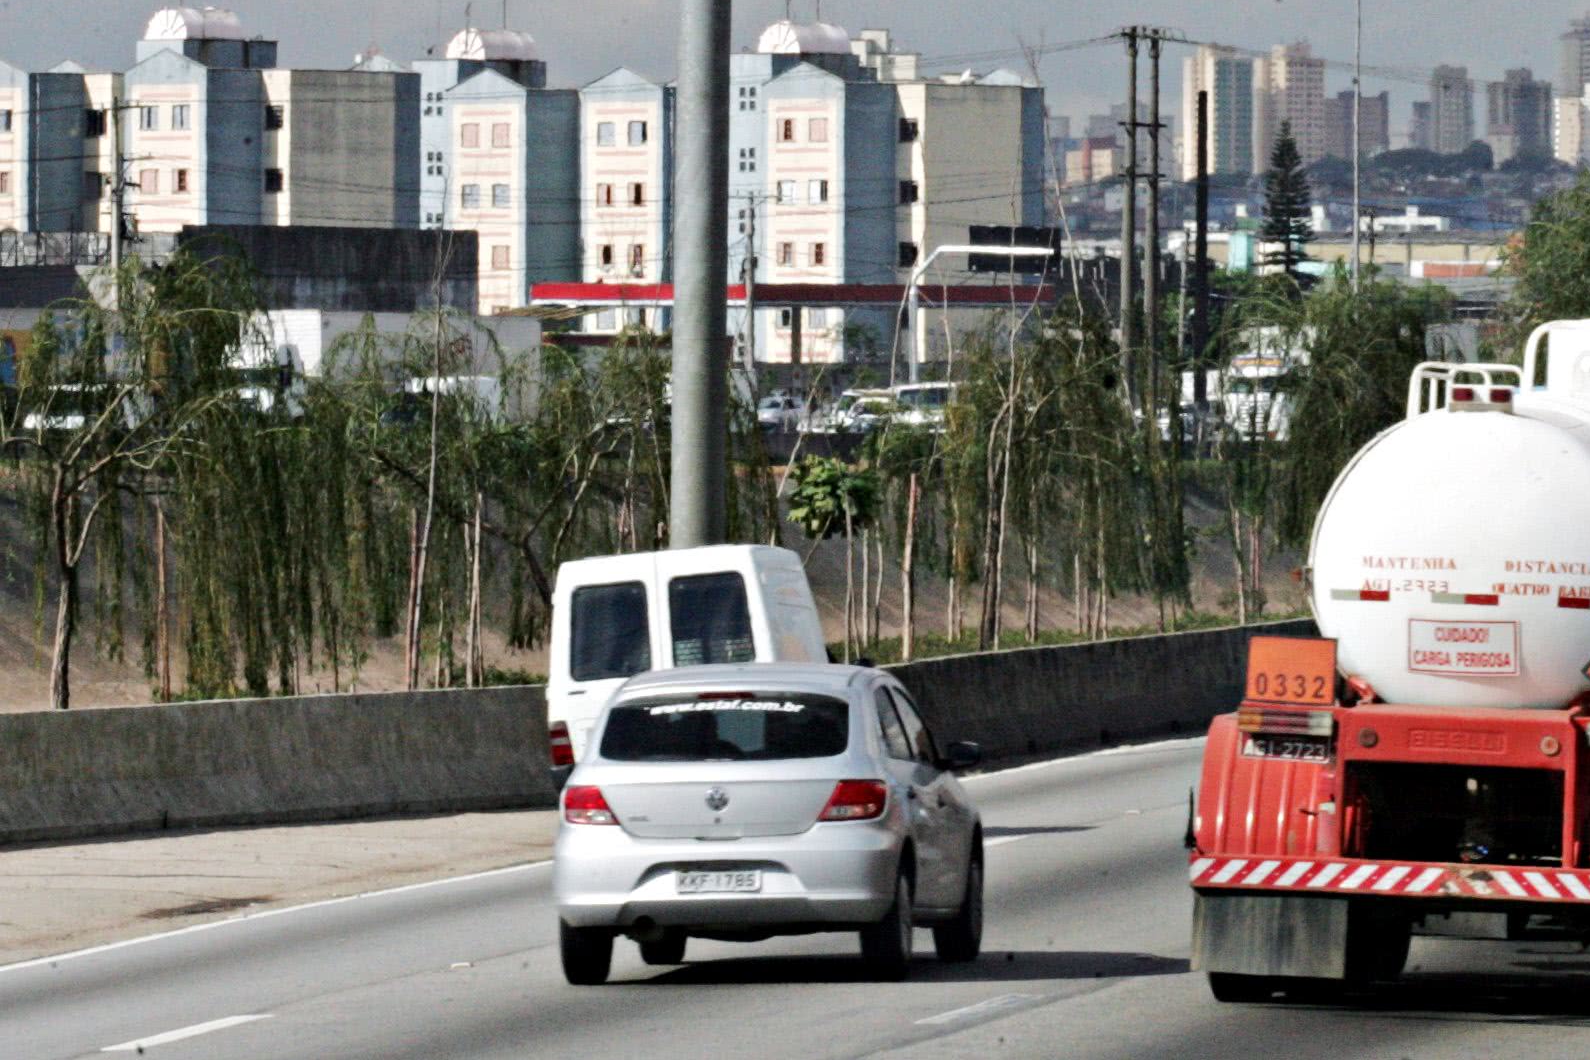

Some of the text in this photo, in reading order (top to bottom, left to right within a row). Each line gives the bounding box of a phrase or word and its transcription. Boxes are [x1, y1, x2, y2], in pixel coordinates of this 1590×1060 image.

[1363, 556, 1457, 570] MANTENHA
[1492, 582, 1551, 596] QUATRO
[1413, 650, 1511, 668] CARGA PERIGOSA
[1255, 672, 1327, 699] 0332
